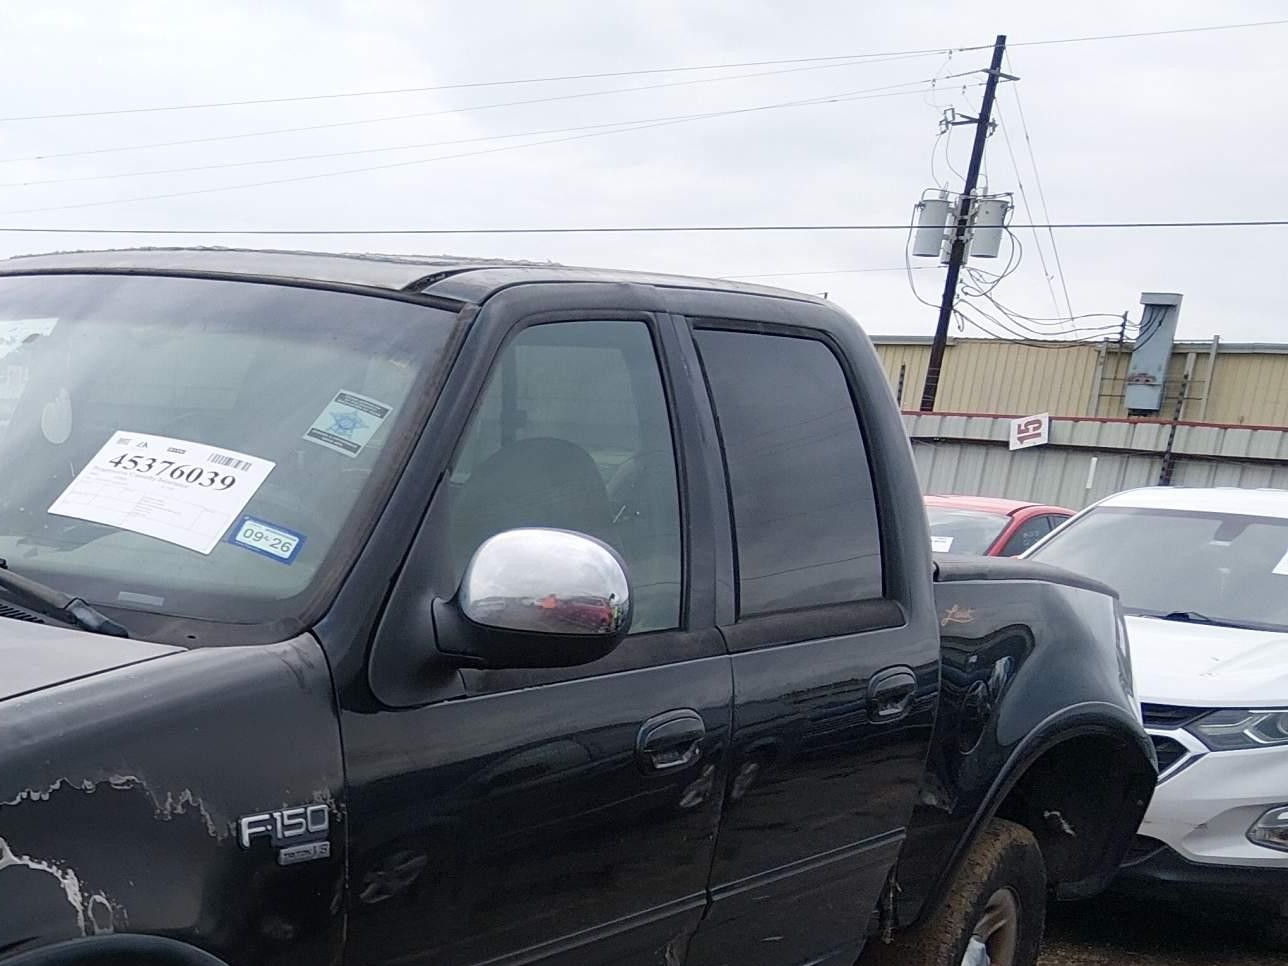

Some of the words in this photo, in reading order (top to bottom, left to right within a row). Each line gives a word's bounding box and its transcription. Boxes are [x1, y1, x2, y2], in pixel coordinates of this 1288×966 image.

[1016, 419, 1043, 445] 15
[108, 453, 237, 491] 45376039
[243, 528, 264, 542] 09
[269, 537, 293, 553] 26
